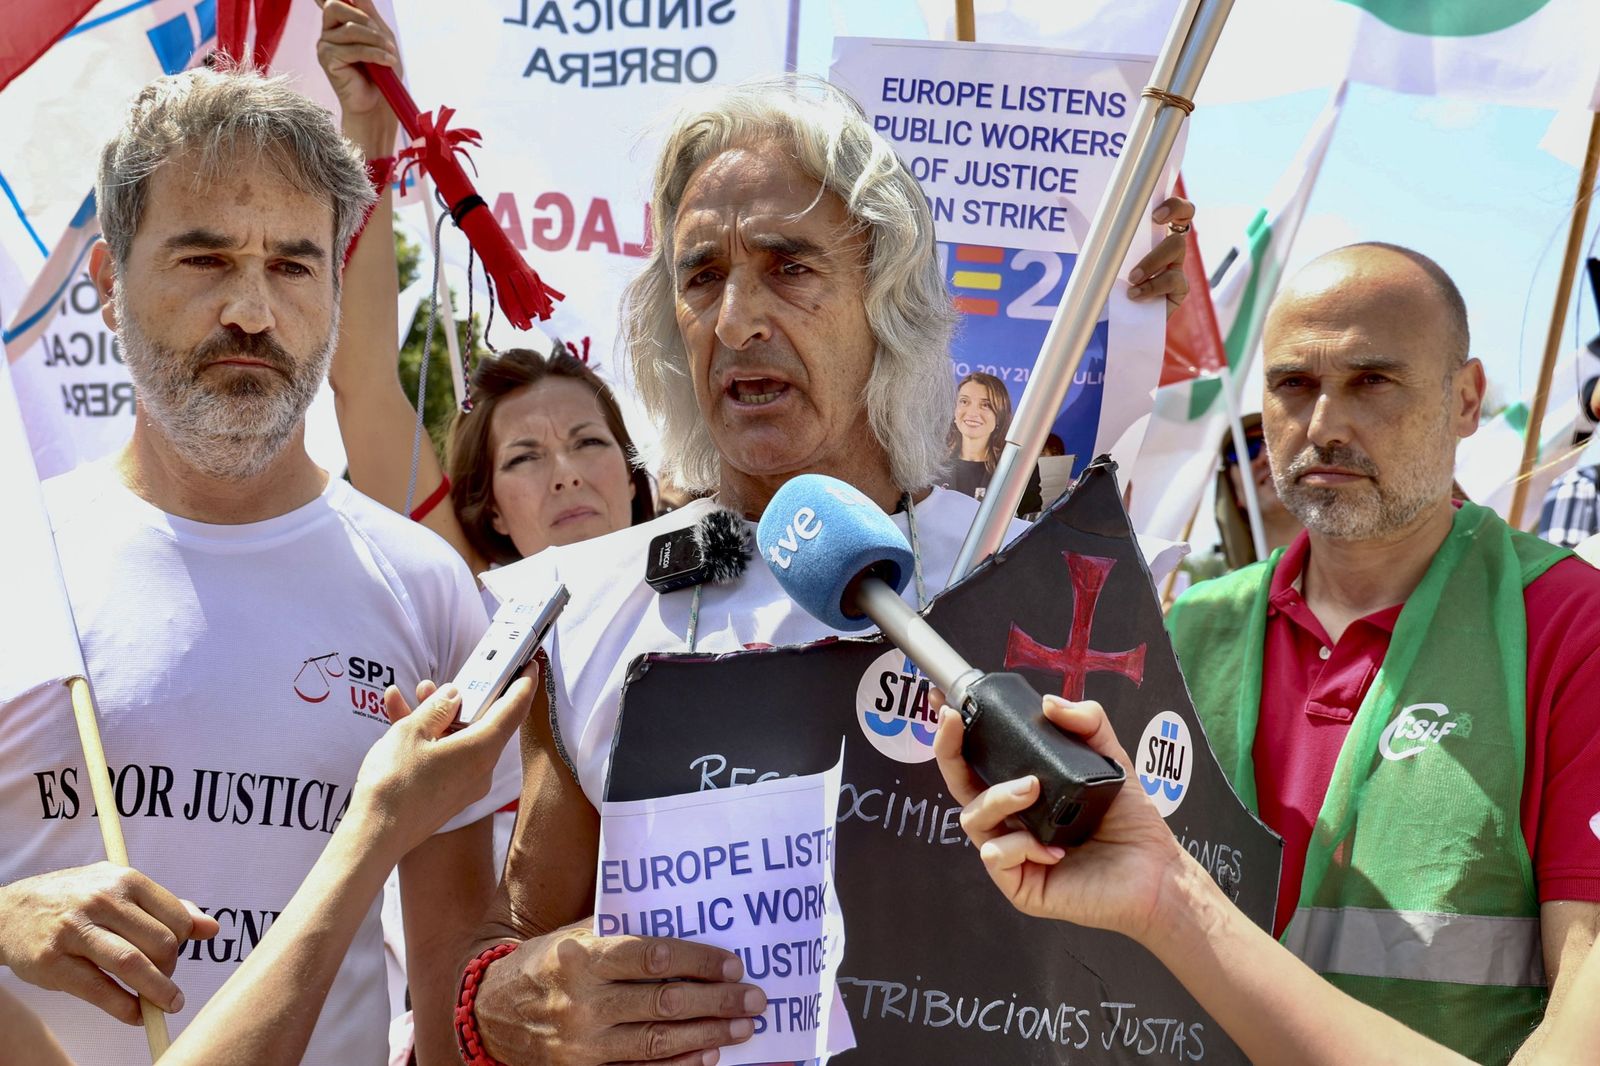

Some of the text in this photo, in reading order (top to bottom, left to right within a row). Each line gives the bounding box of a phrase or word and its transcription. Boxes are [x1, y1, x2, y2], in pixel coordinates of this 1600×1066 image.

[882, 77, 1127, 118] EUROPE LISTENS
[874, 115, 1127, 158] PUBLIC WORKERS
[910, 156, 1079, 194] OF JUSTICE
[962, 199, 1068, 233] STRIKE
[1000, 367, 1012, 380] Y
[1013, 368, 1030, 382] 21
[769, 506, 823, 569] tve
[348, 656, 395, 688] SPJ
[1146, 736, 1185, 781] STAJ
[34, 767, 80, 820] ES
[601, 841, 752, 894] EUROPE
[734, 935, 828, 979] USTICE
[1100, 1001, 1205, 1062] JUSTAS
